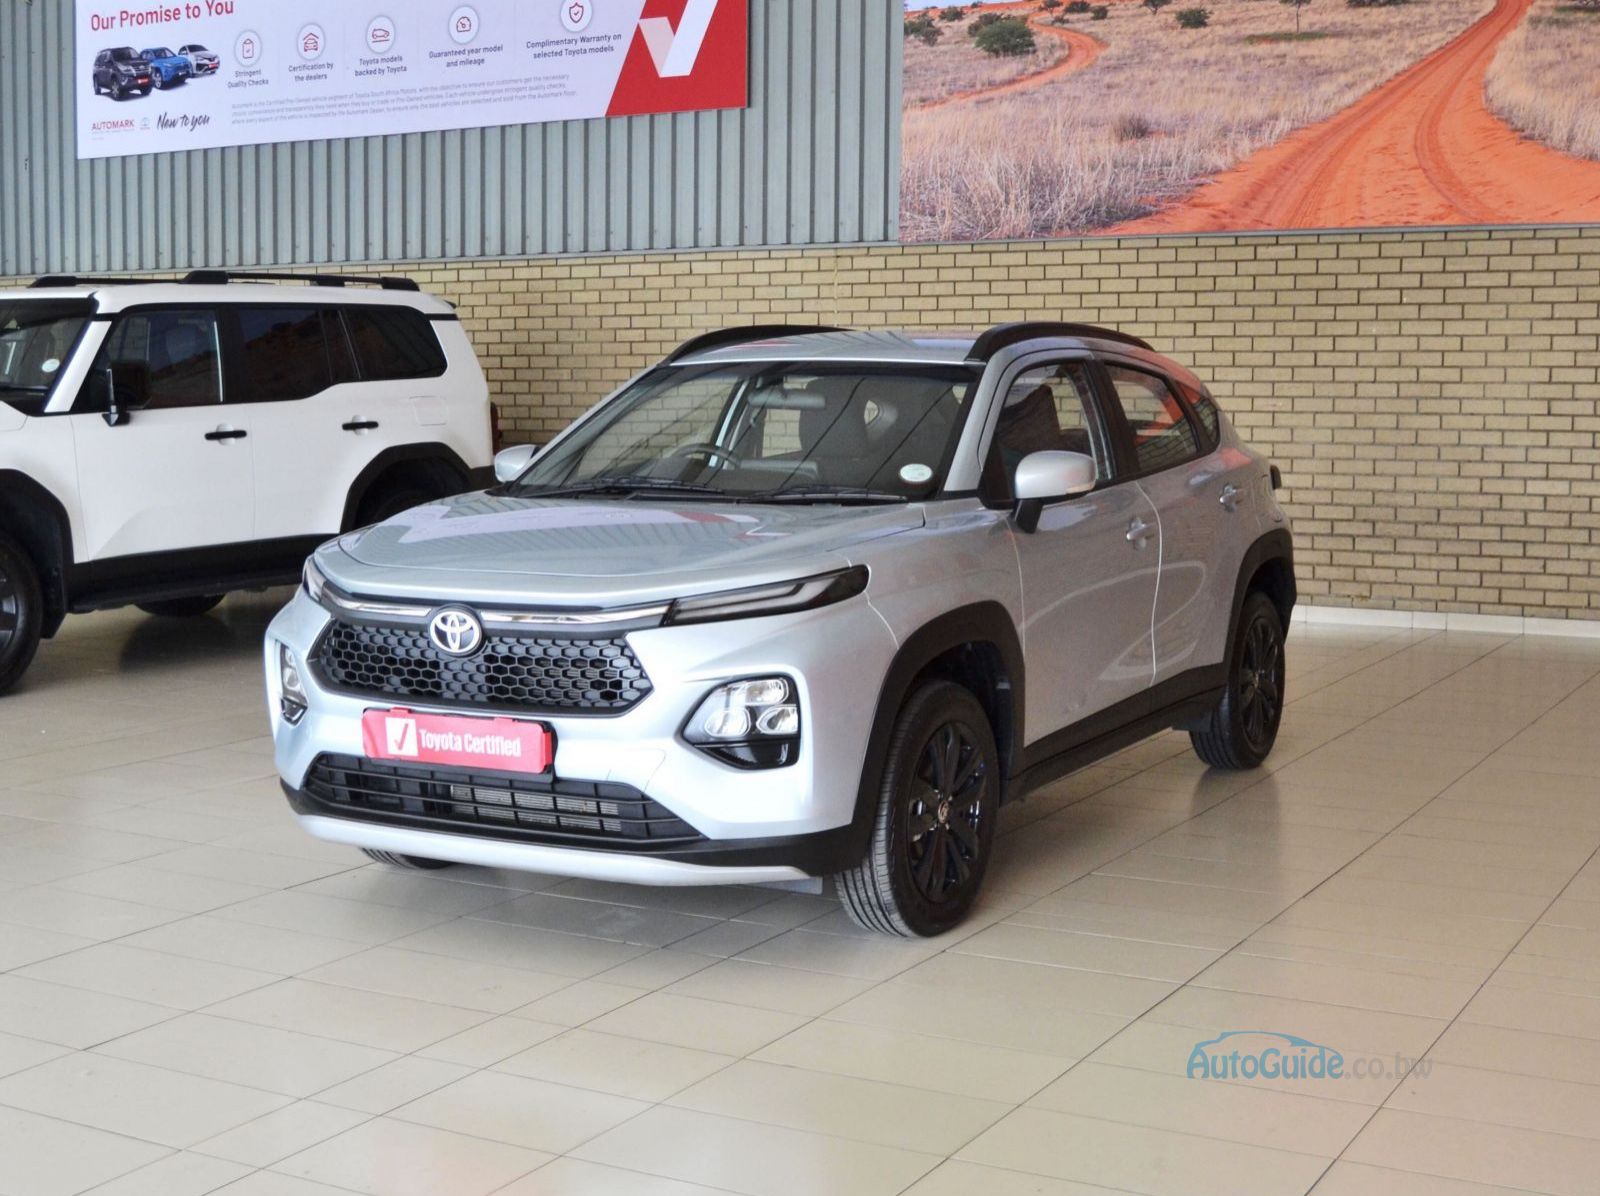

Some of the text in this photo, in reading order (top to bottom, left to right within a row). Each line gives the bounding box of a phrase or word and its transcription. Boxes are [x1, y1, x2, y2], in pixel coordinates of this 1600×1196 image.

[91, 0, 234, 31] Our Promise to You
[526, 38, 579, 49] Complimentary
[580, 35, 611, 44] Warranty
[429, 45, 504, 59] Guaranteed year model
[533, 45, 615, 59] selected Toyota models
[359, 54, 403, 66] Toyota models
[446, 57, 485, 68] and mileage
[288, 62, 334, 73] Certification by
[355, 66, 407, 77] backed by Toyota
[235, 69, 262, 79] Stringent
[295, 73, 328, 82] the dealers
[228, 78, 269, 89] Quality Checks
[92, 119, 134, 131] AUTOMARK
[190, 114, 210, 132] you
[419, 729, 521, 758] Toyota Certified
